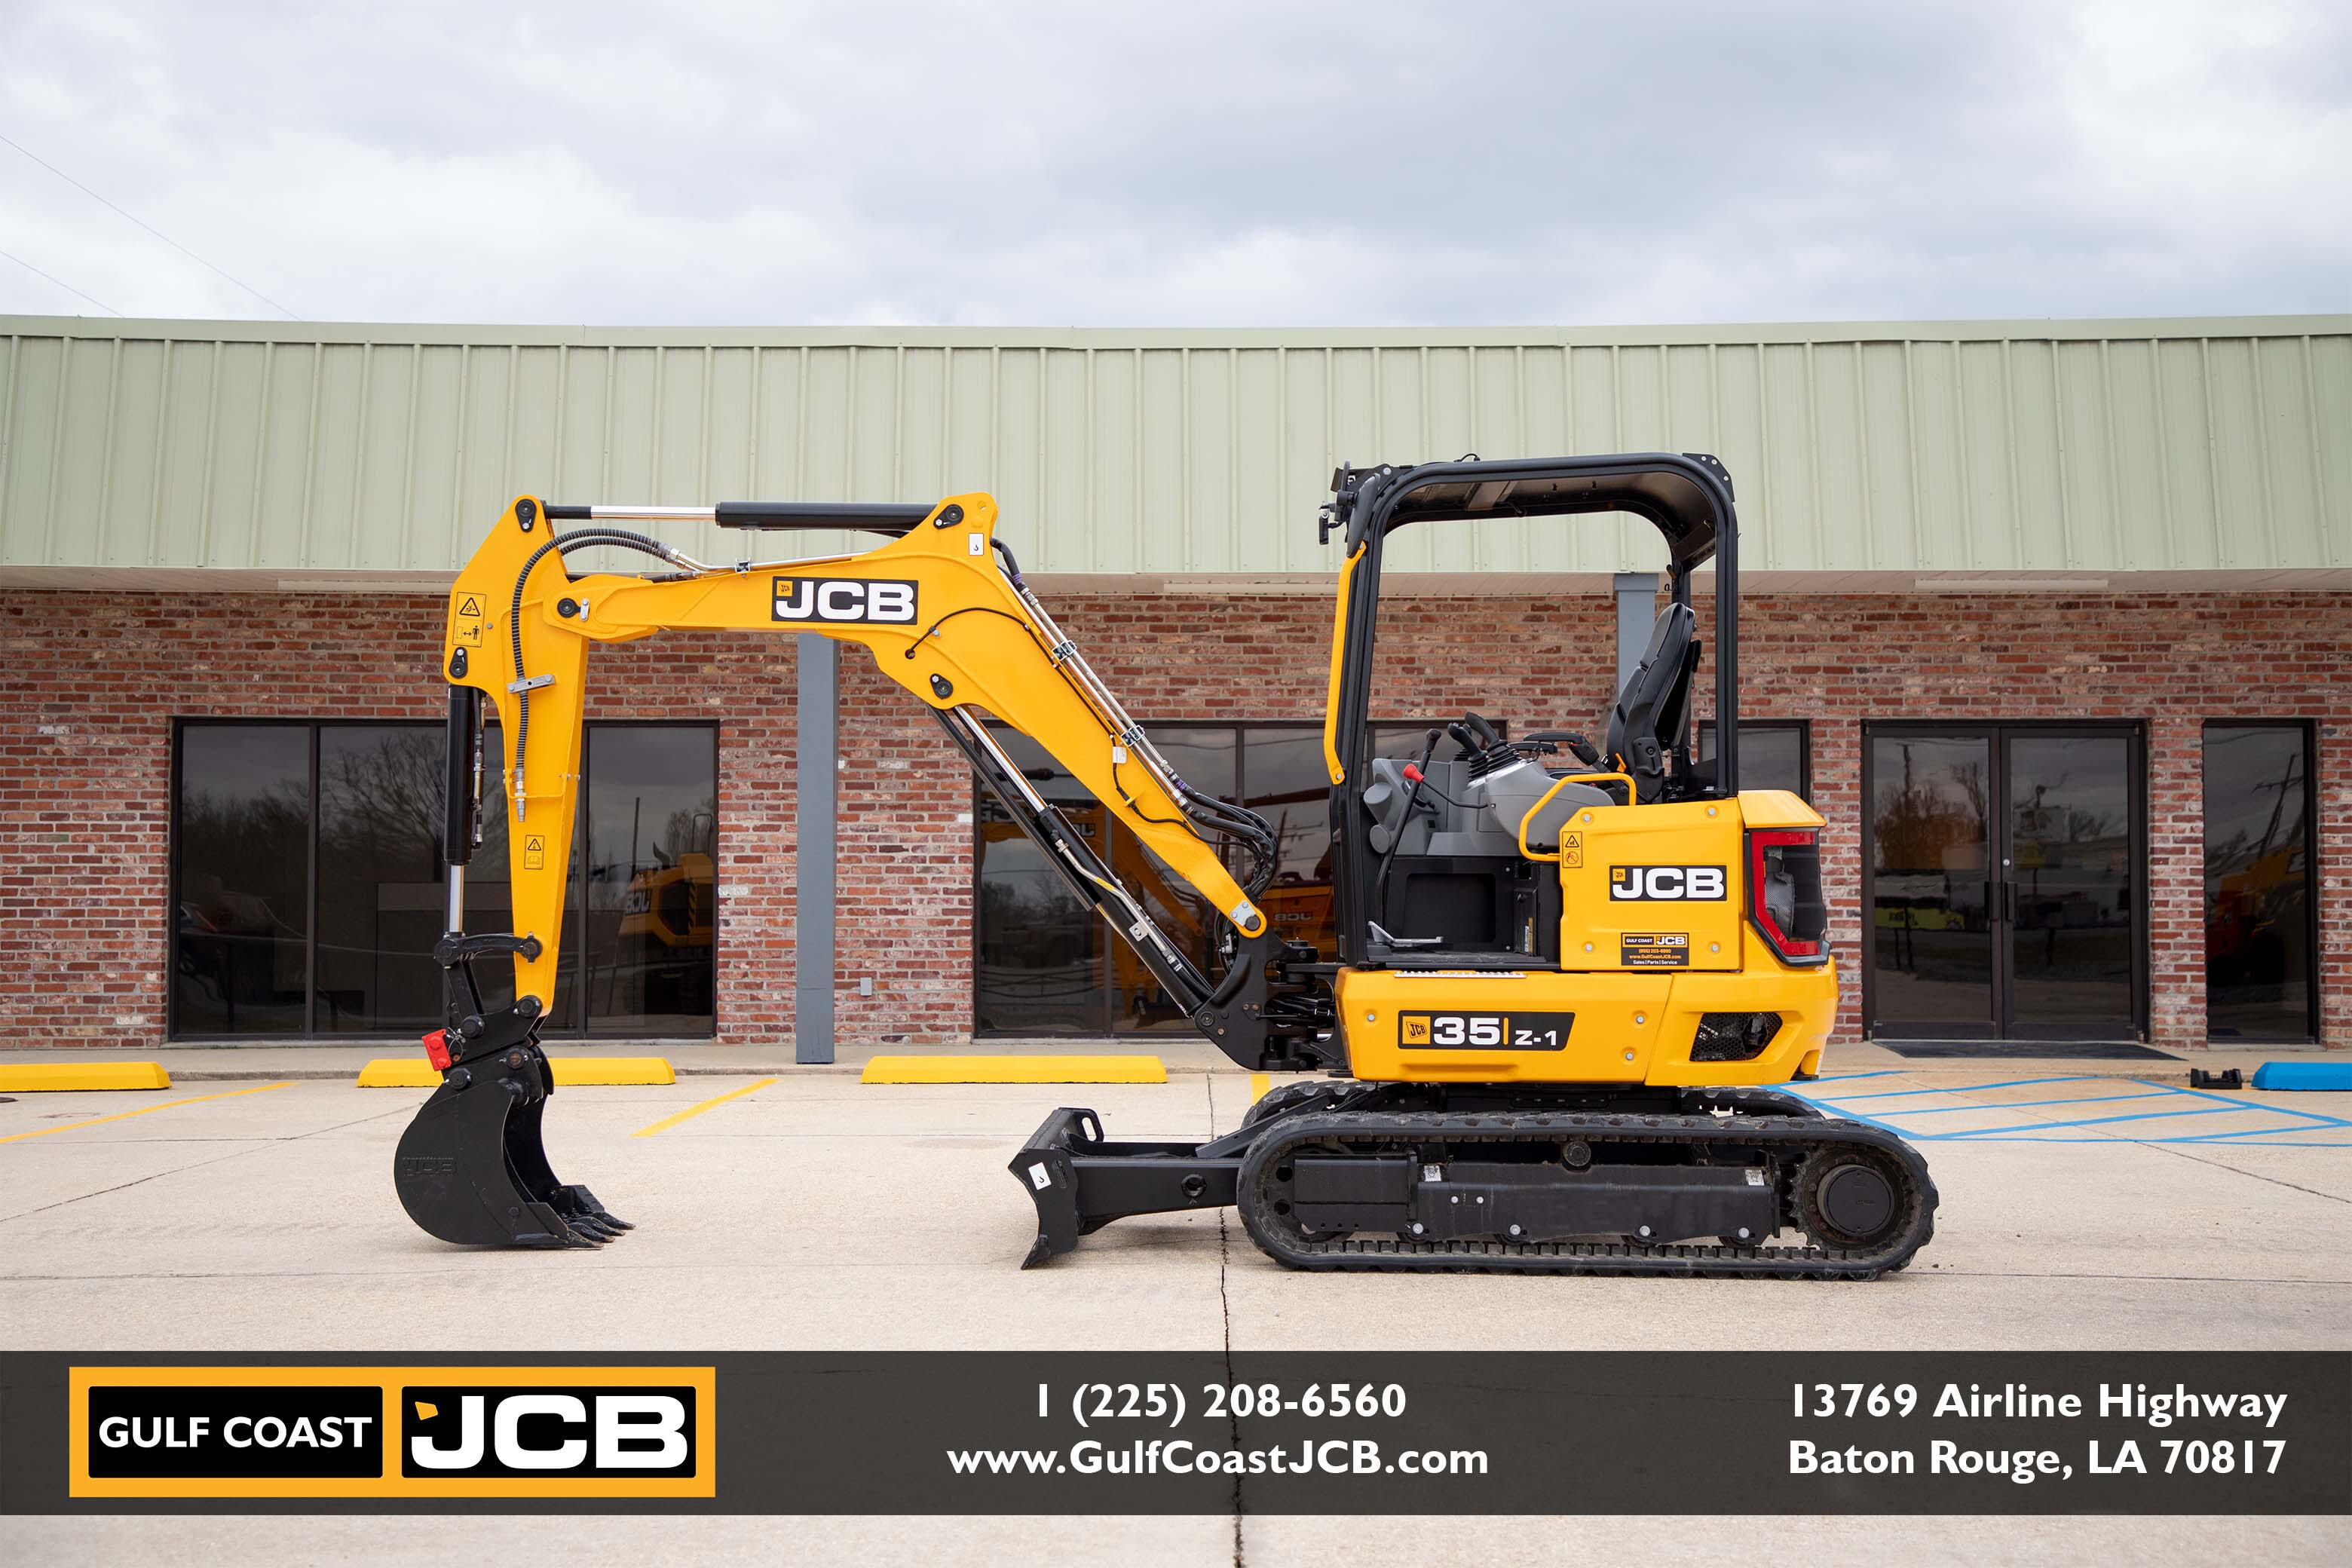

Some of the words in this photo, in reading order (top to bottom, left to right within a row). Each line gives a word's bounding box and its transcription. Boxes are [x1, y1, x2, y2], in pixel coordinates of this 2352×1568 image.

[776, 580, 914, 621] JCB
[1612, 868, 1725, 899] JCB
[1656, 936, 1685, 945] JCB
[1409, 1023, 1426, 1037] JCB
[1433, 1016, 1501, 1046] 35
[1514, 1030, 1557, 1046] Z-1
